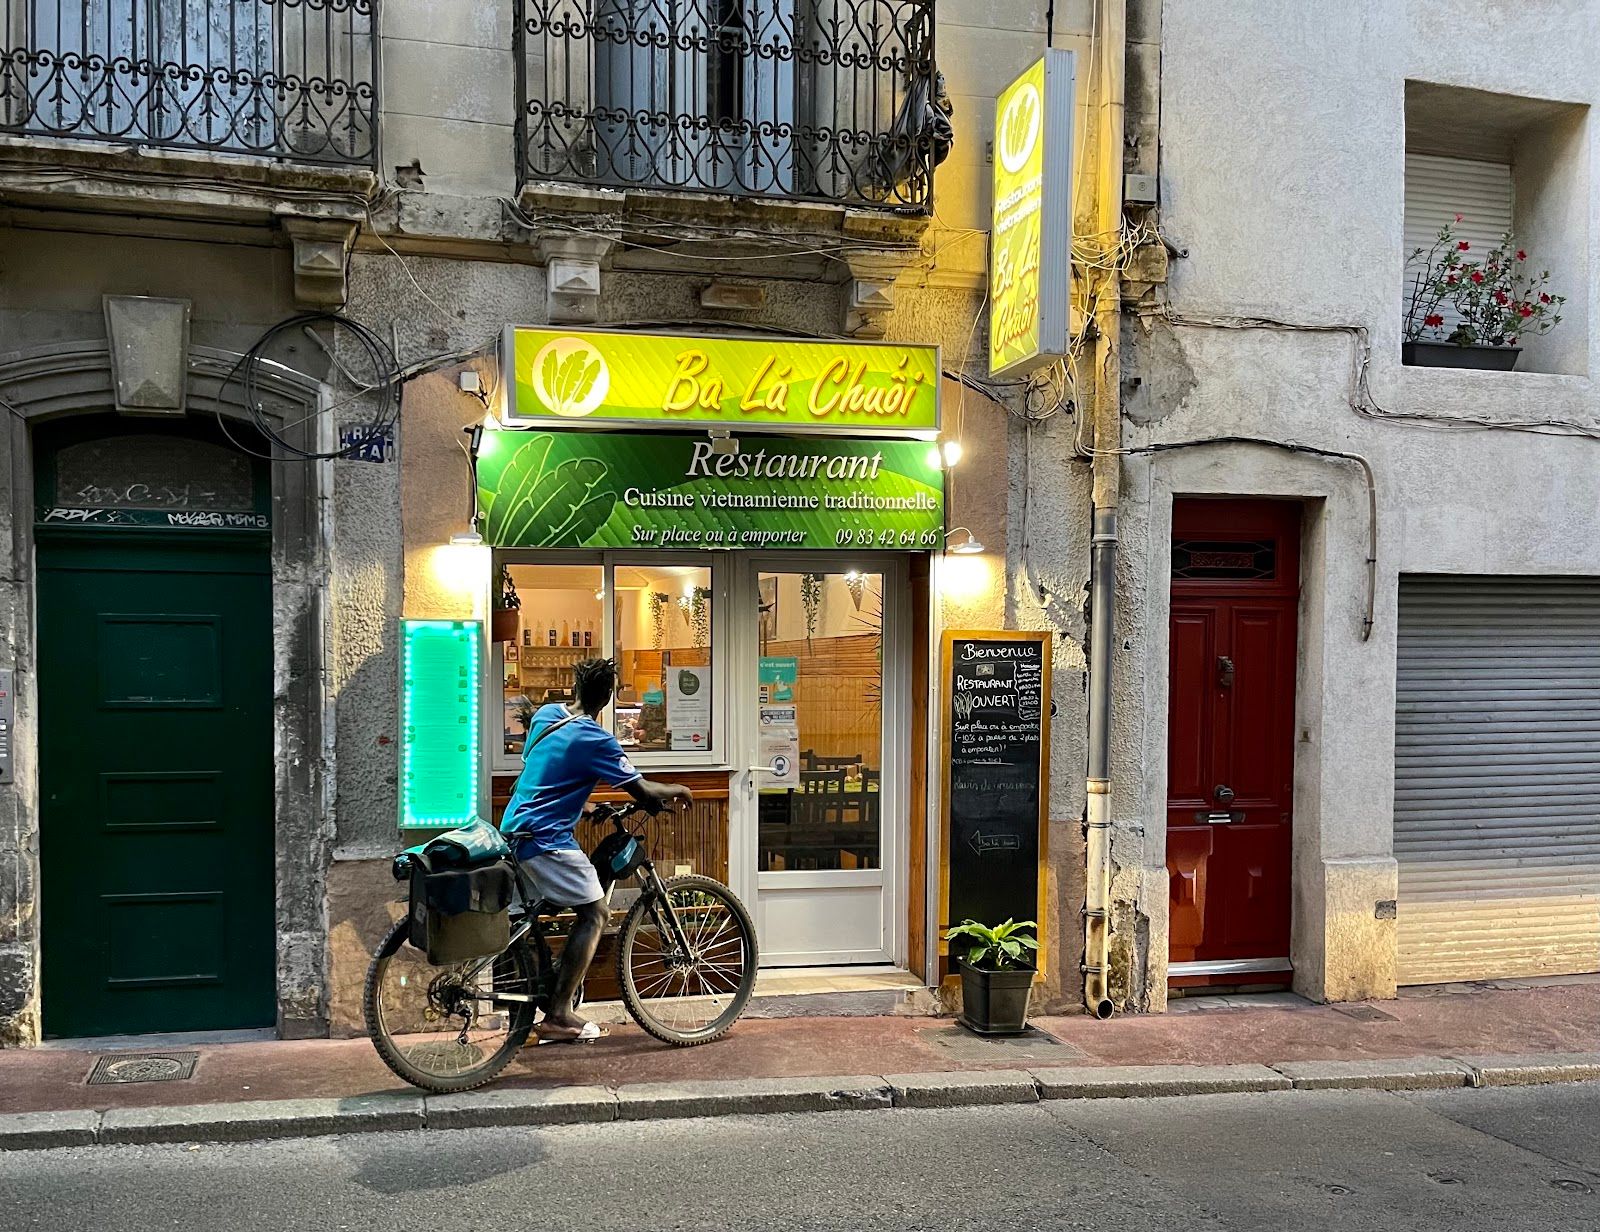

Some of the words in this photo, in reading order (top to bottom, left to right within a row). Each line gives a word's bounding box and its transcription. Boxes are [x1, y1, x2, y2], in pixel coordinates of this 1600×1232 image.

[992, 247, 1014, 302] Ba
[661, 349, 723, 413] Ba
[740, 354, 793, 414] Lá
[685, 441, 882, 480] Restaurant
[623, 486, 694, 508] Cuisine
[699, 490, 819, 509] vietnamienne
[823, 491, 937, 511] traditionnelle
[631, 524, 658, 542] Sur
[660, 526, 702, 546] place
[705, 530, 725, 542] ou
[728, 525, 738, 542] à
[741, 529, 807, 547] emporter
[834, 528, 853, 545] 09
[856, 528, 875, 545] 83
[878, 528, 896, 545] 42
[899, 528, 917, 545] 64
[920, 528, 938, 545] 66
[961, 643, 1039, 660] Bienvenue
[972, 694, 1017, 708] OUVERT
